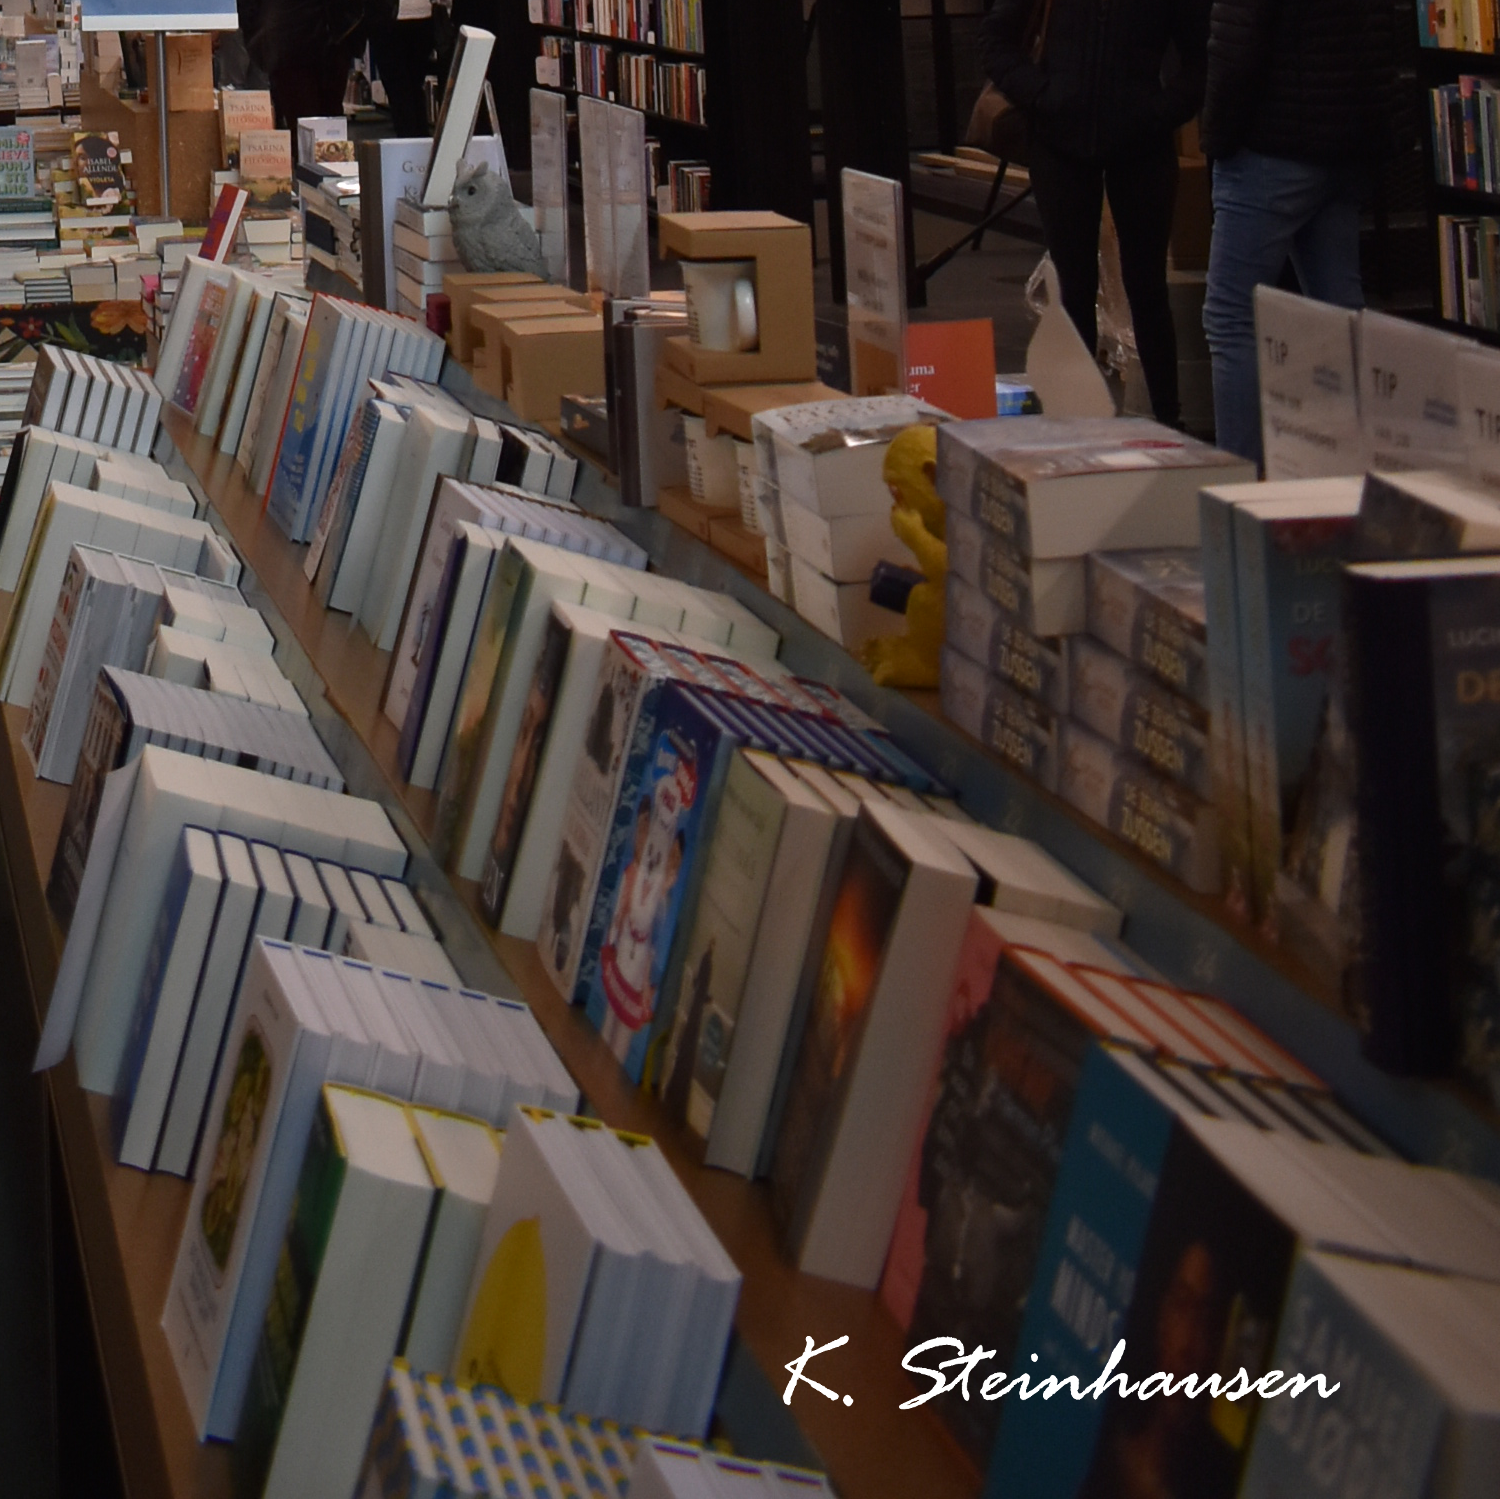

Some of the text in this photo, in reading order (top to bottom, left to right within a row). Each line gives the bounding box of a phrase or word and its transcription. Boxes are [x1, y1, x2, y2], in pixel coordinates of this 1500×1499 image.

[87, 157, 112, 165] ISABEL
[1265, 337, 1288, 366] TIP
[1371, 366, 1397, 399] TIP
